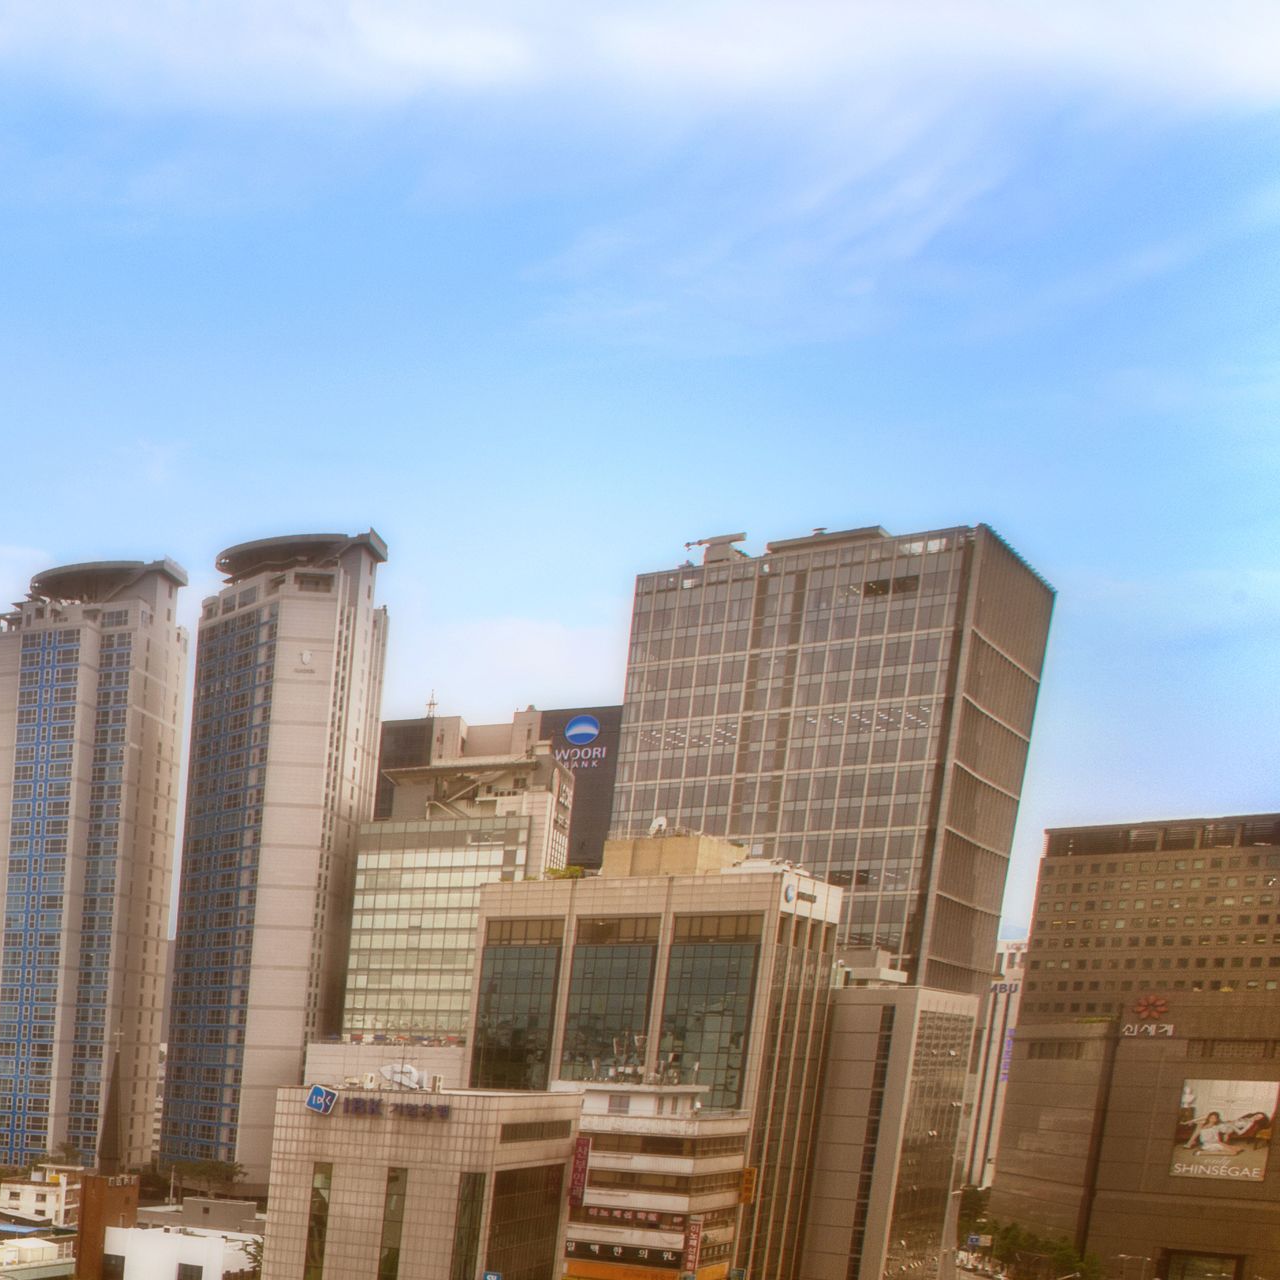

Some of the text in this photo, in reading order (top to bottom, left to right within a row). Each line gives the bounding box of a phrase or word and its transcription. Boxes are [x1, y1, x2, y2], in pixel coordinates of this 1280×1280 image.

[555, 746, 607, 760] WOORI
[1121, 1022, 1176, 1038] 신세계
[1173, 1162, 1263, 1179] SHINSEGAE
